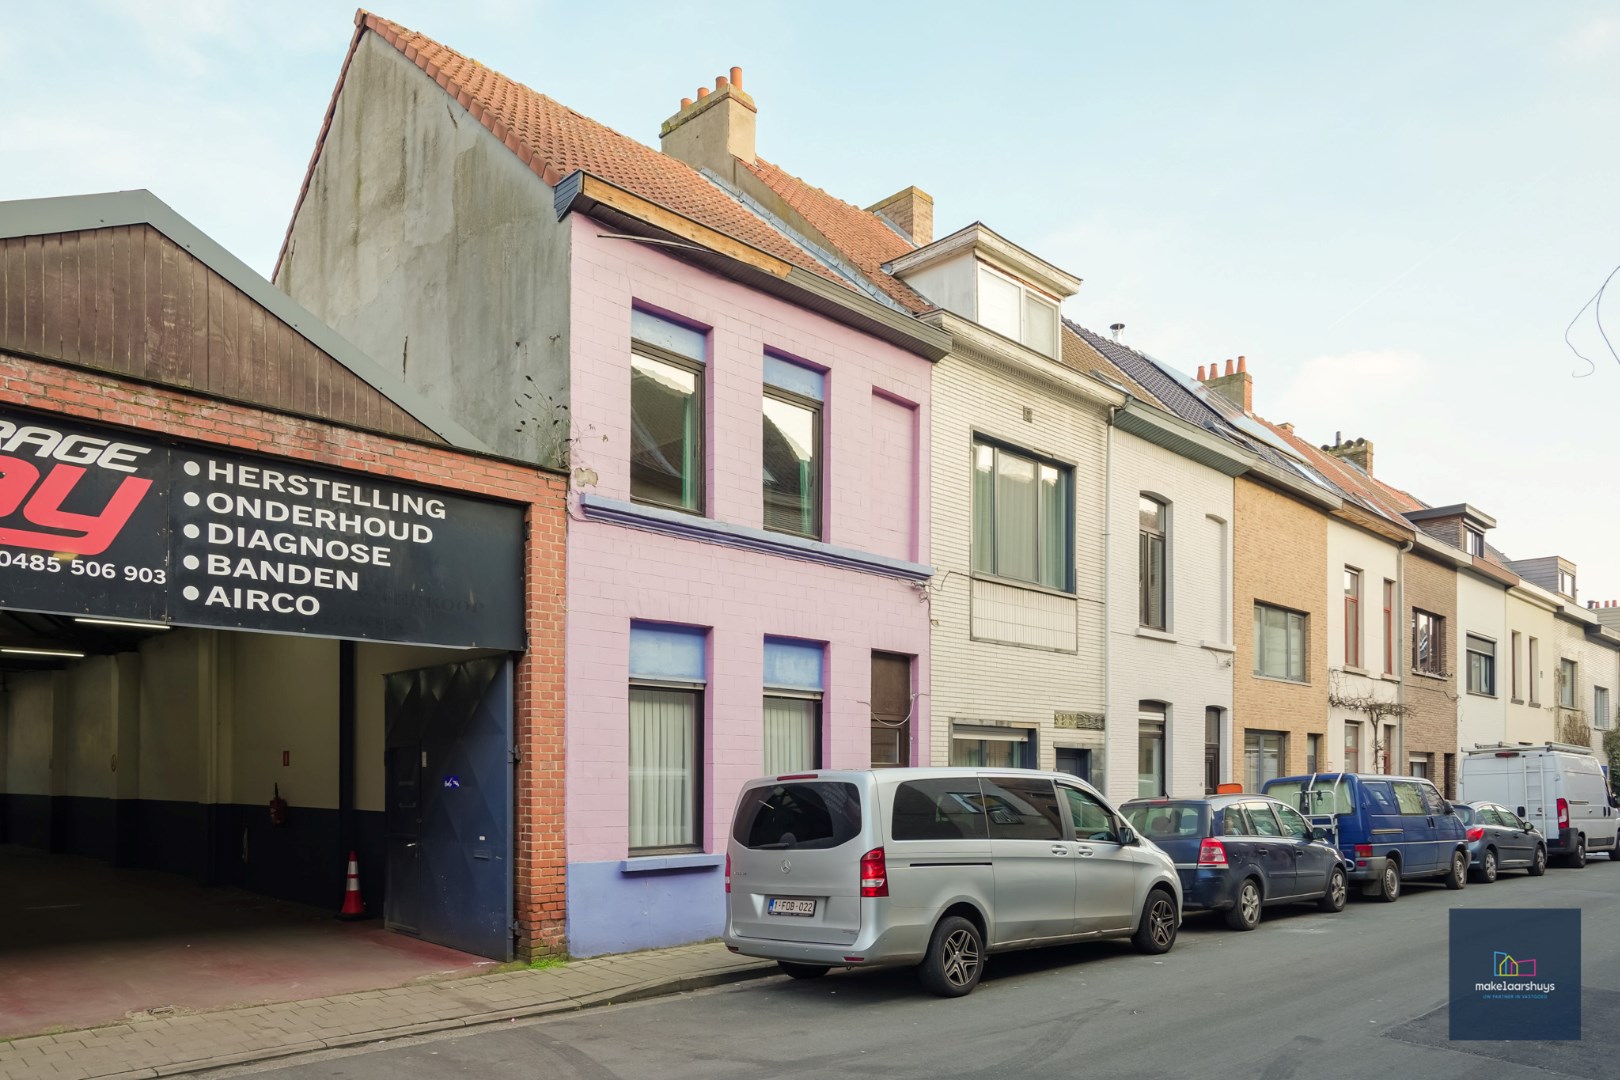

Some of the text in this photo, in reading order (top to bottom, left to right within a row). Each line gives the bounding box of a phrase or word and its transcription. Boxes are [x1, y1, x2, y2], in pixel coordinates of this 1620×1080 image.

[208, 460, 447, 520] HERSTELLING
[206, 492, 434, 544] ONDERHOUD
[208, 522, 392, 567] DIAGNOSE
[0, 551, 167, 585] 0485 506 903
[207, 553, 359, 591] BANDEN
[204, 585, 321, 616] AIRCO
